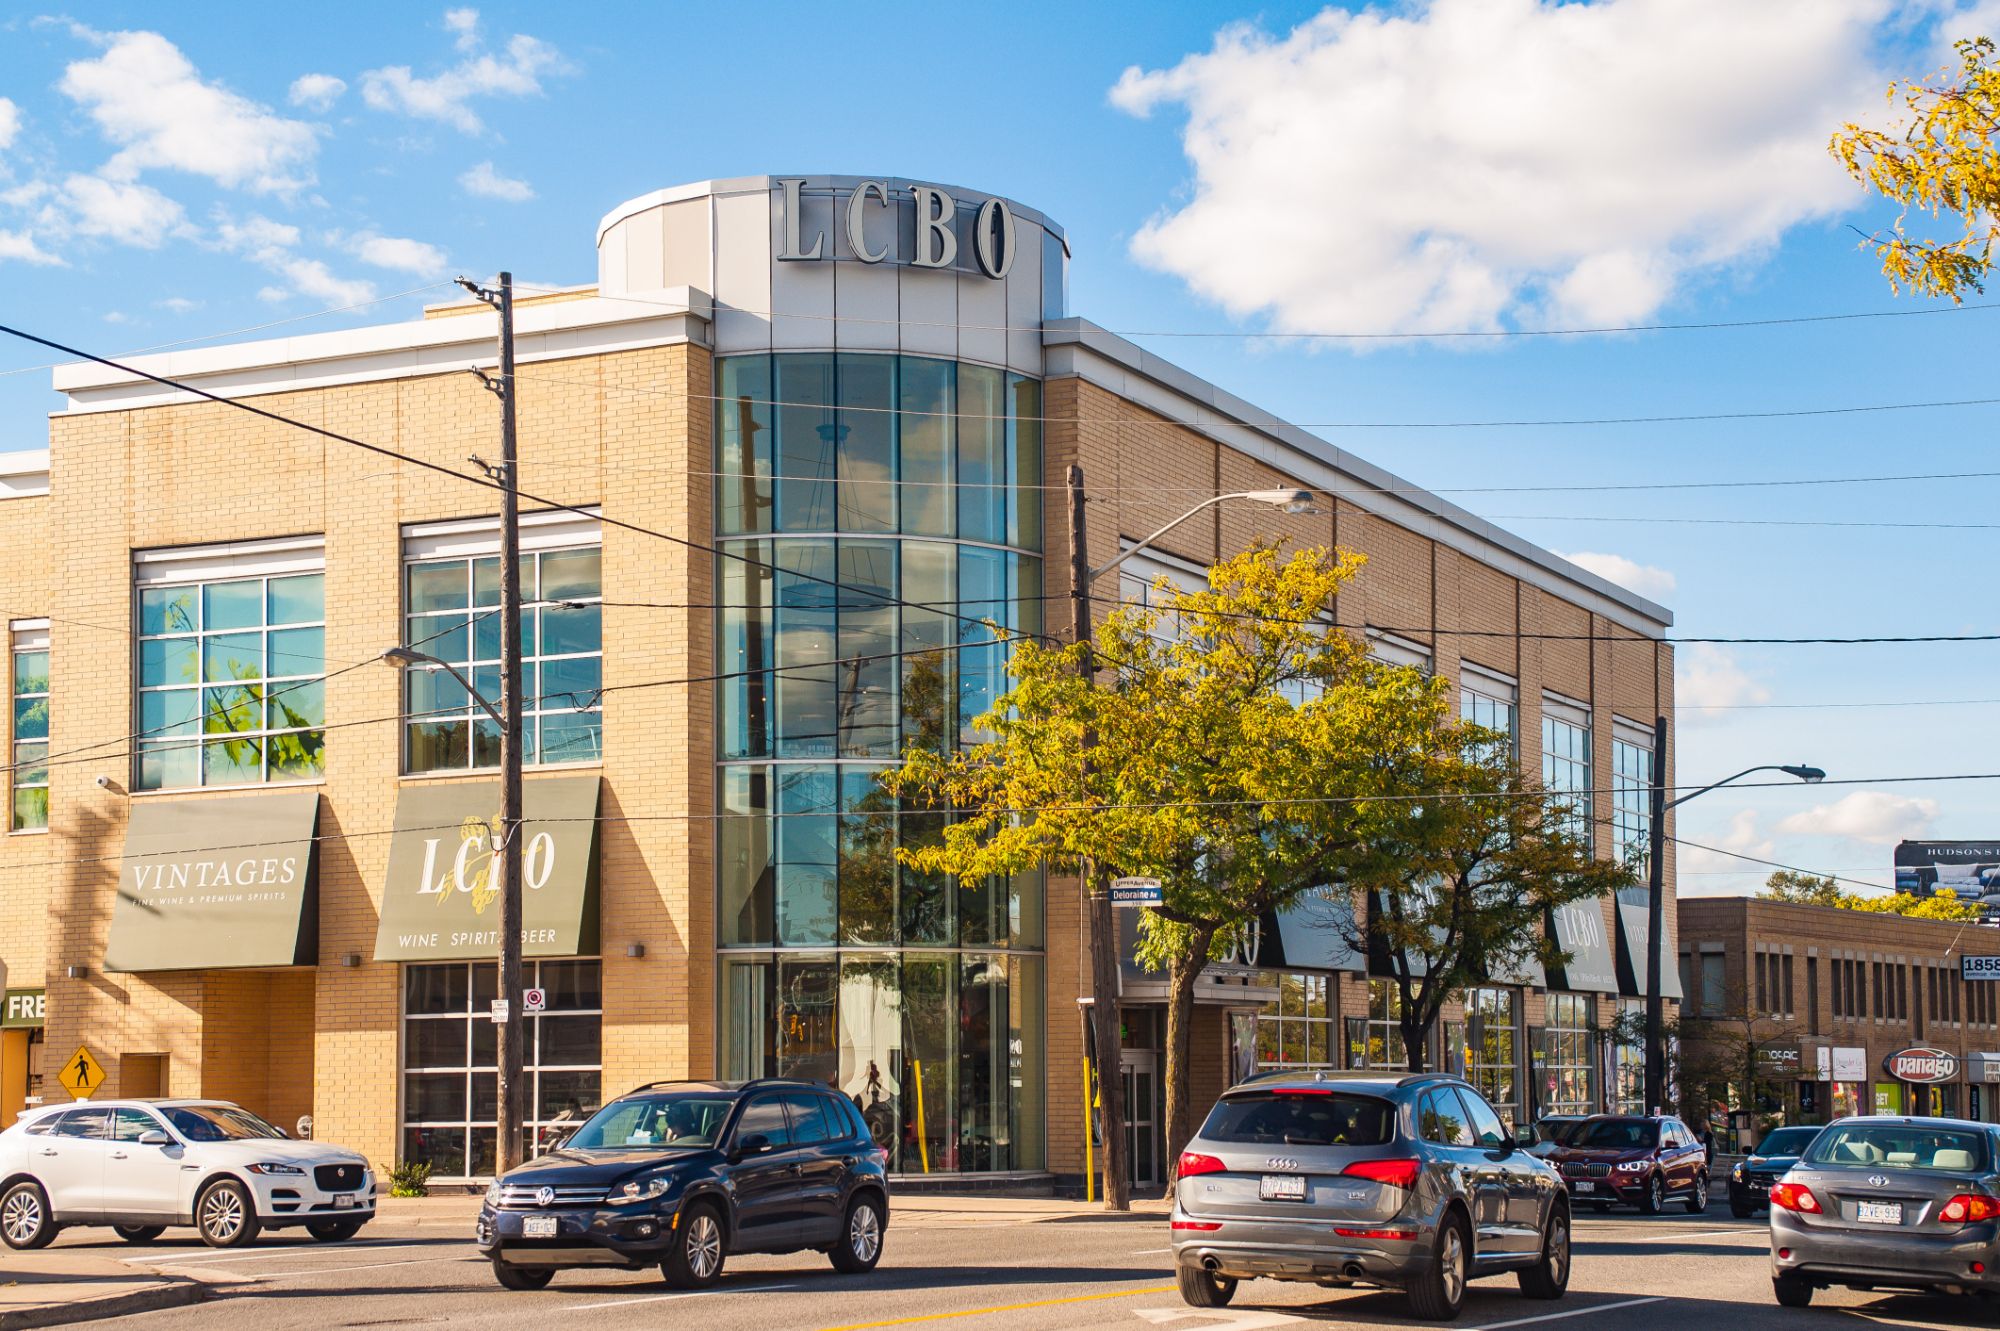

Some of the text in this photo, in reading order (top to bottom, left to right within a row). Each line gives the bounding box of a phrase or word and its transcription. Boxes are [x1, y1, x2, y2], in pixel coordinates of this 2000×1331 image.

[776, 178, 1016, 280] LCBO
[1928, 848, 1992, 856] HUDSON'S
[133, 857, 297, 891] VINTAGES
[132, 899, 154, 907] FINE
[159, 897, 184, 905] WINE
[200, 894, 242, 903] PREMIUM
[247, 892, 286, 901] SPIRITS
[1113, 890, 1149, 899] Deloraine
[1562, 907, 1600, 949] LCBO
[399, 929, 556, 948] WINE SPIRIT BEER
[1965, 959, 2000, 971] 1858
[8, 995, 46, 1019] FRE
[1897, 1052, 1955, 1078] panago
[1876, 1092, 1889, 1106] GET
